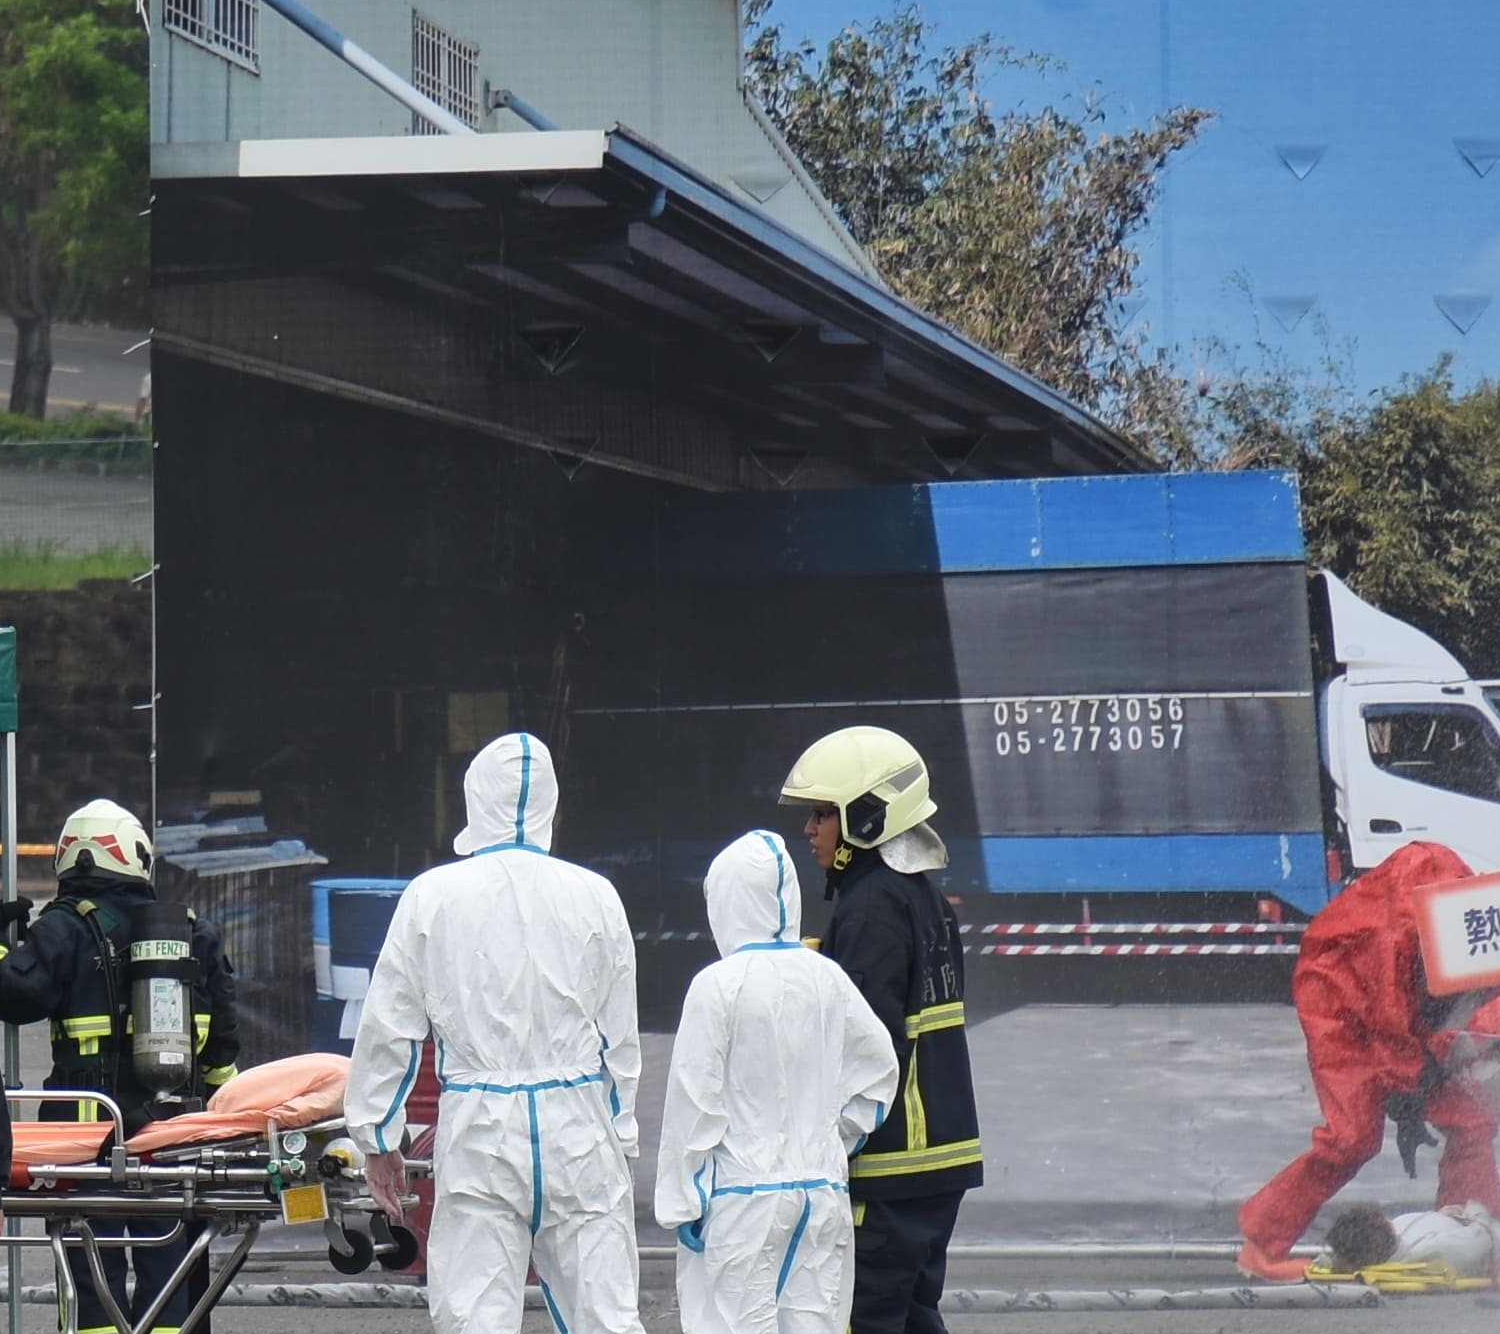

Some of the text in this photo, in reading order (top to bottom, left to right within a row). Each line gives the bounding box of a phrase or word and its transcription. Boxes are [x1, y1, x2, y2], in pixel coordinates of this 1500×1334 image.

[993, 698, 1184, 726] 05-2773056
[996, 724, 1184, 756] 05-2773057
[155, 941, 184, 956] FENZY
